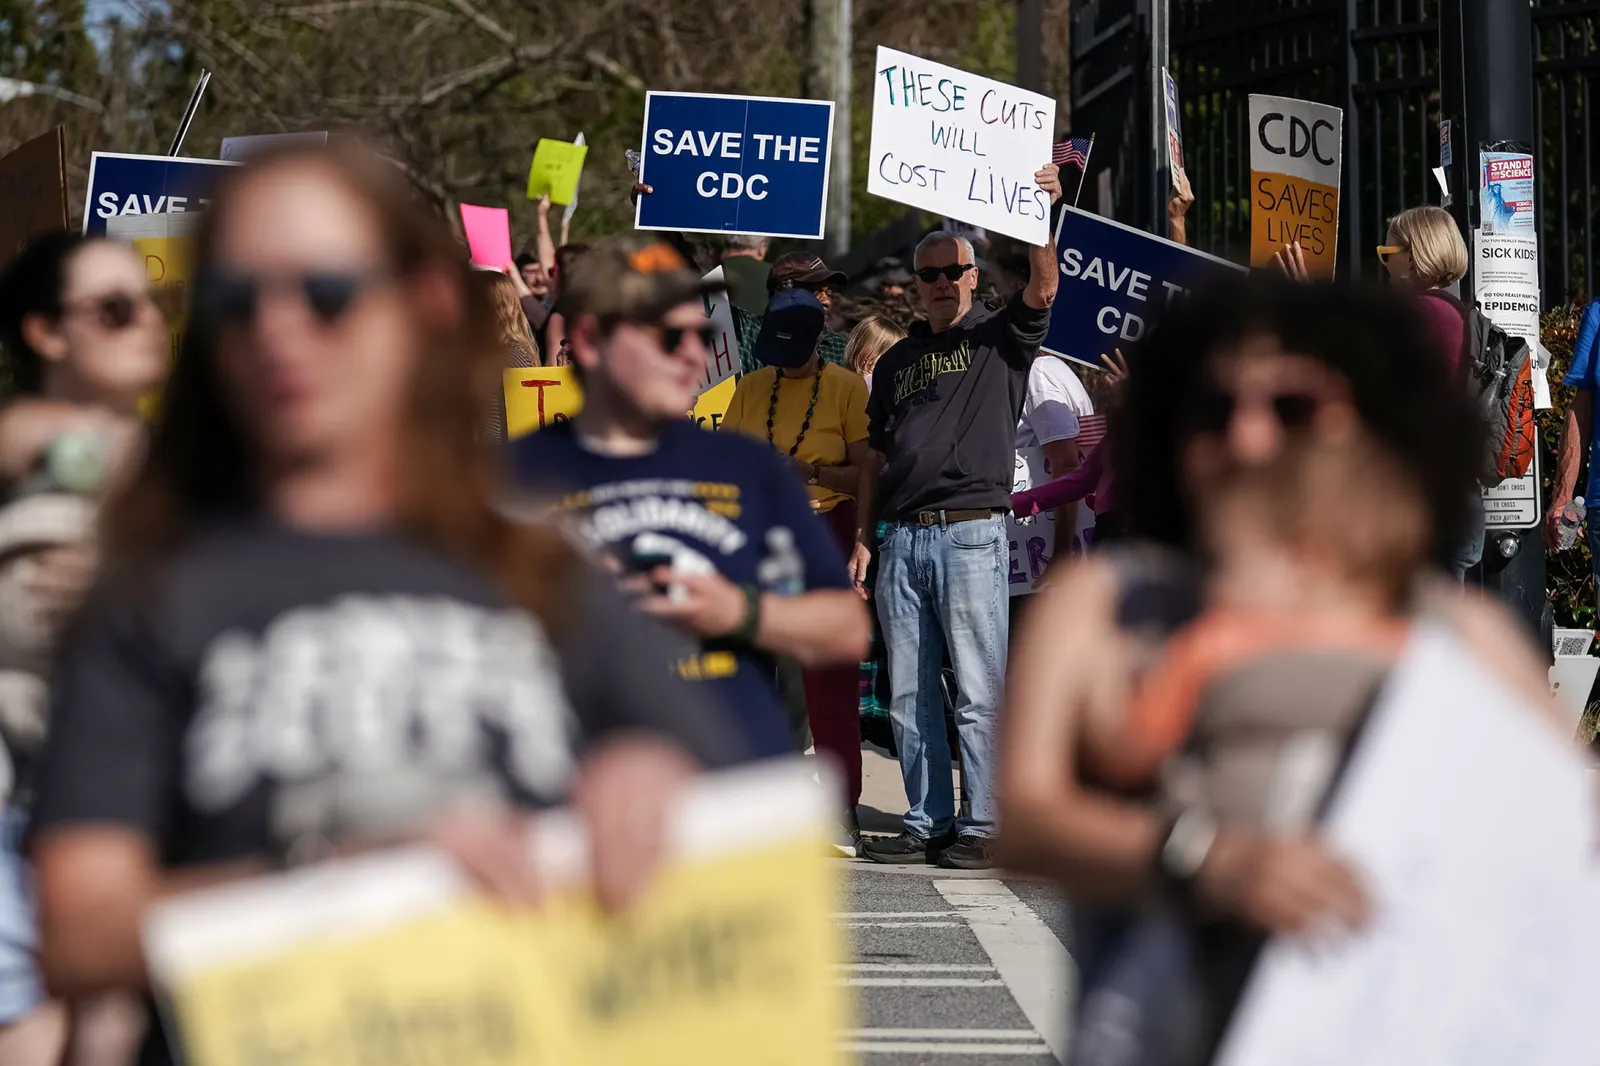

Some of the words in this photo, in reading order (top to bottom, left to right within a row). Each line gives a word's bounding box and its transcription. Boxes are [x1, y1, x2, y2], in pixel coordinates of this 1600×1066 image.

[878, 65, 967, 112] THESE
[980, 89, 1047, 130] CUTS
[652, 128, 742, 159] SAVE
[753, 134, 821, 163] THE
[1258, 112, 1335, 166] CDC
[879, 152, 946, 191] COST
[1491, 161, 1521, 171] STAND
[1523, 160, 1531, 169] UP
[1500, 168, 1531, 179] SCIENCE
[696, 171, 769, 201] CDC
[1258, 178, 1335, 224] SAVES
[96, 192, 188, 219] SAVE
[1268, 218, 1325, 256] LIVES
[1482, 247, 1512, 259] SICK
[1060, 248, 1152, 302] SAVE
[1097, 305, 1150, 343] CD
